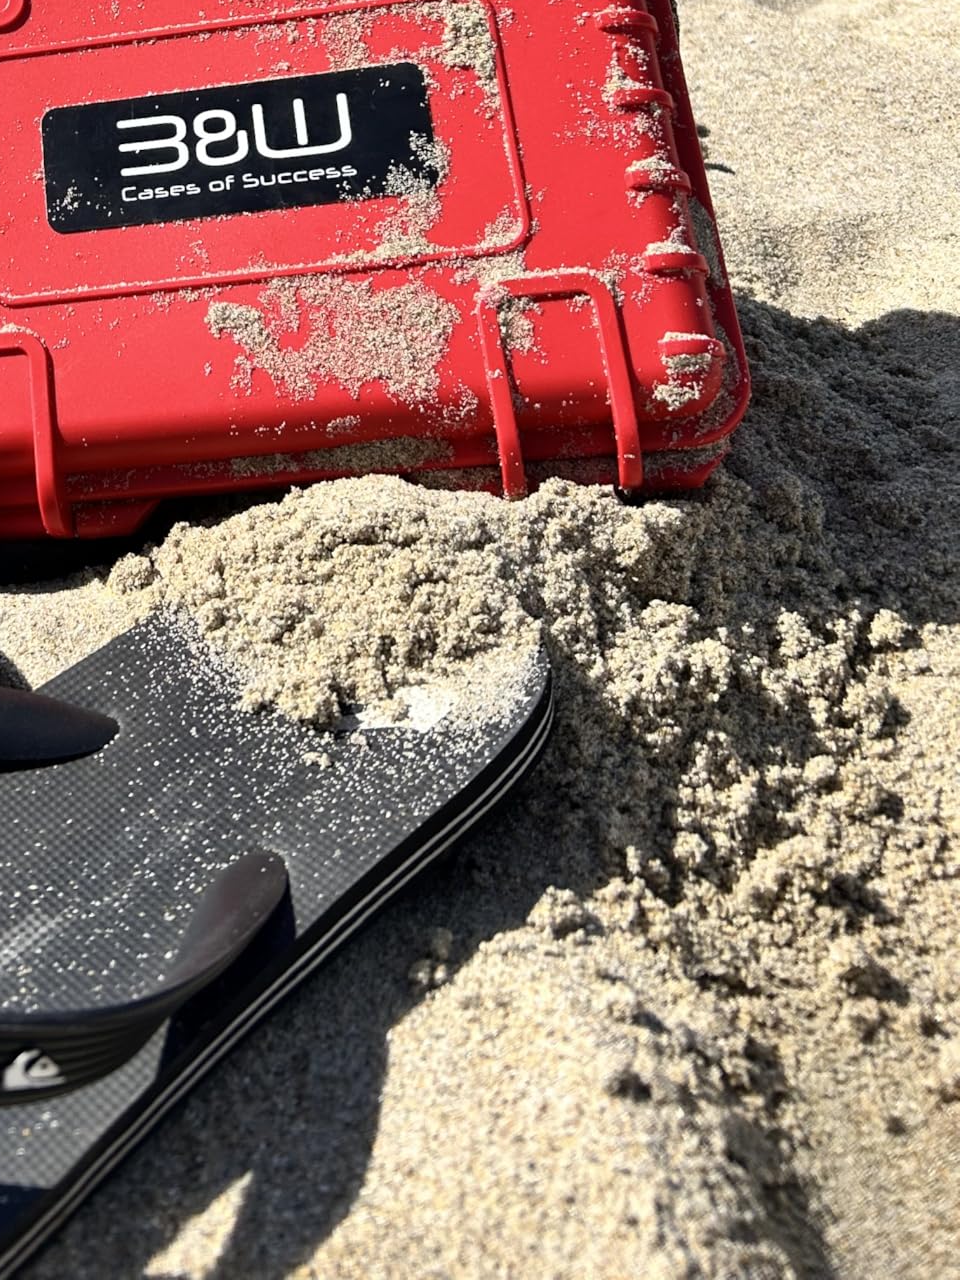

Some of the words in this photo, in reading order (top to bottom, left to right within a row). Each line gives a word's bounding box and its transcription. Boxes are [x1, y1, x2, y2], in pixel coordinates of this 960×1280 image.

[121, 181, 202, 202] Cases
[208, 174, 235, 193] of
[242, 163, 359, 188] Success
